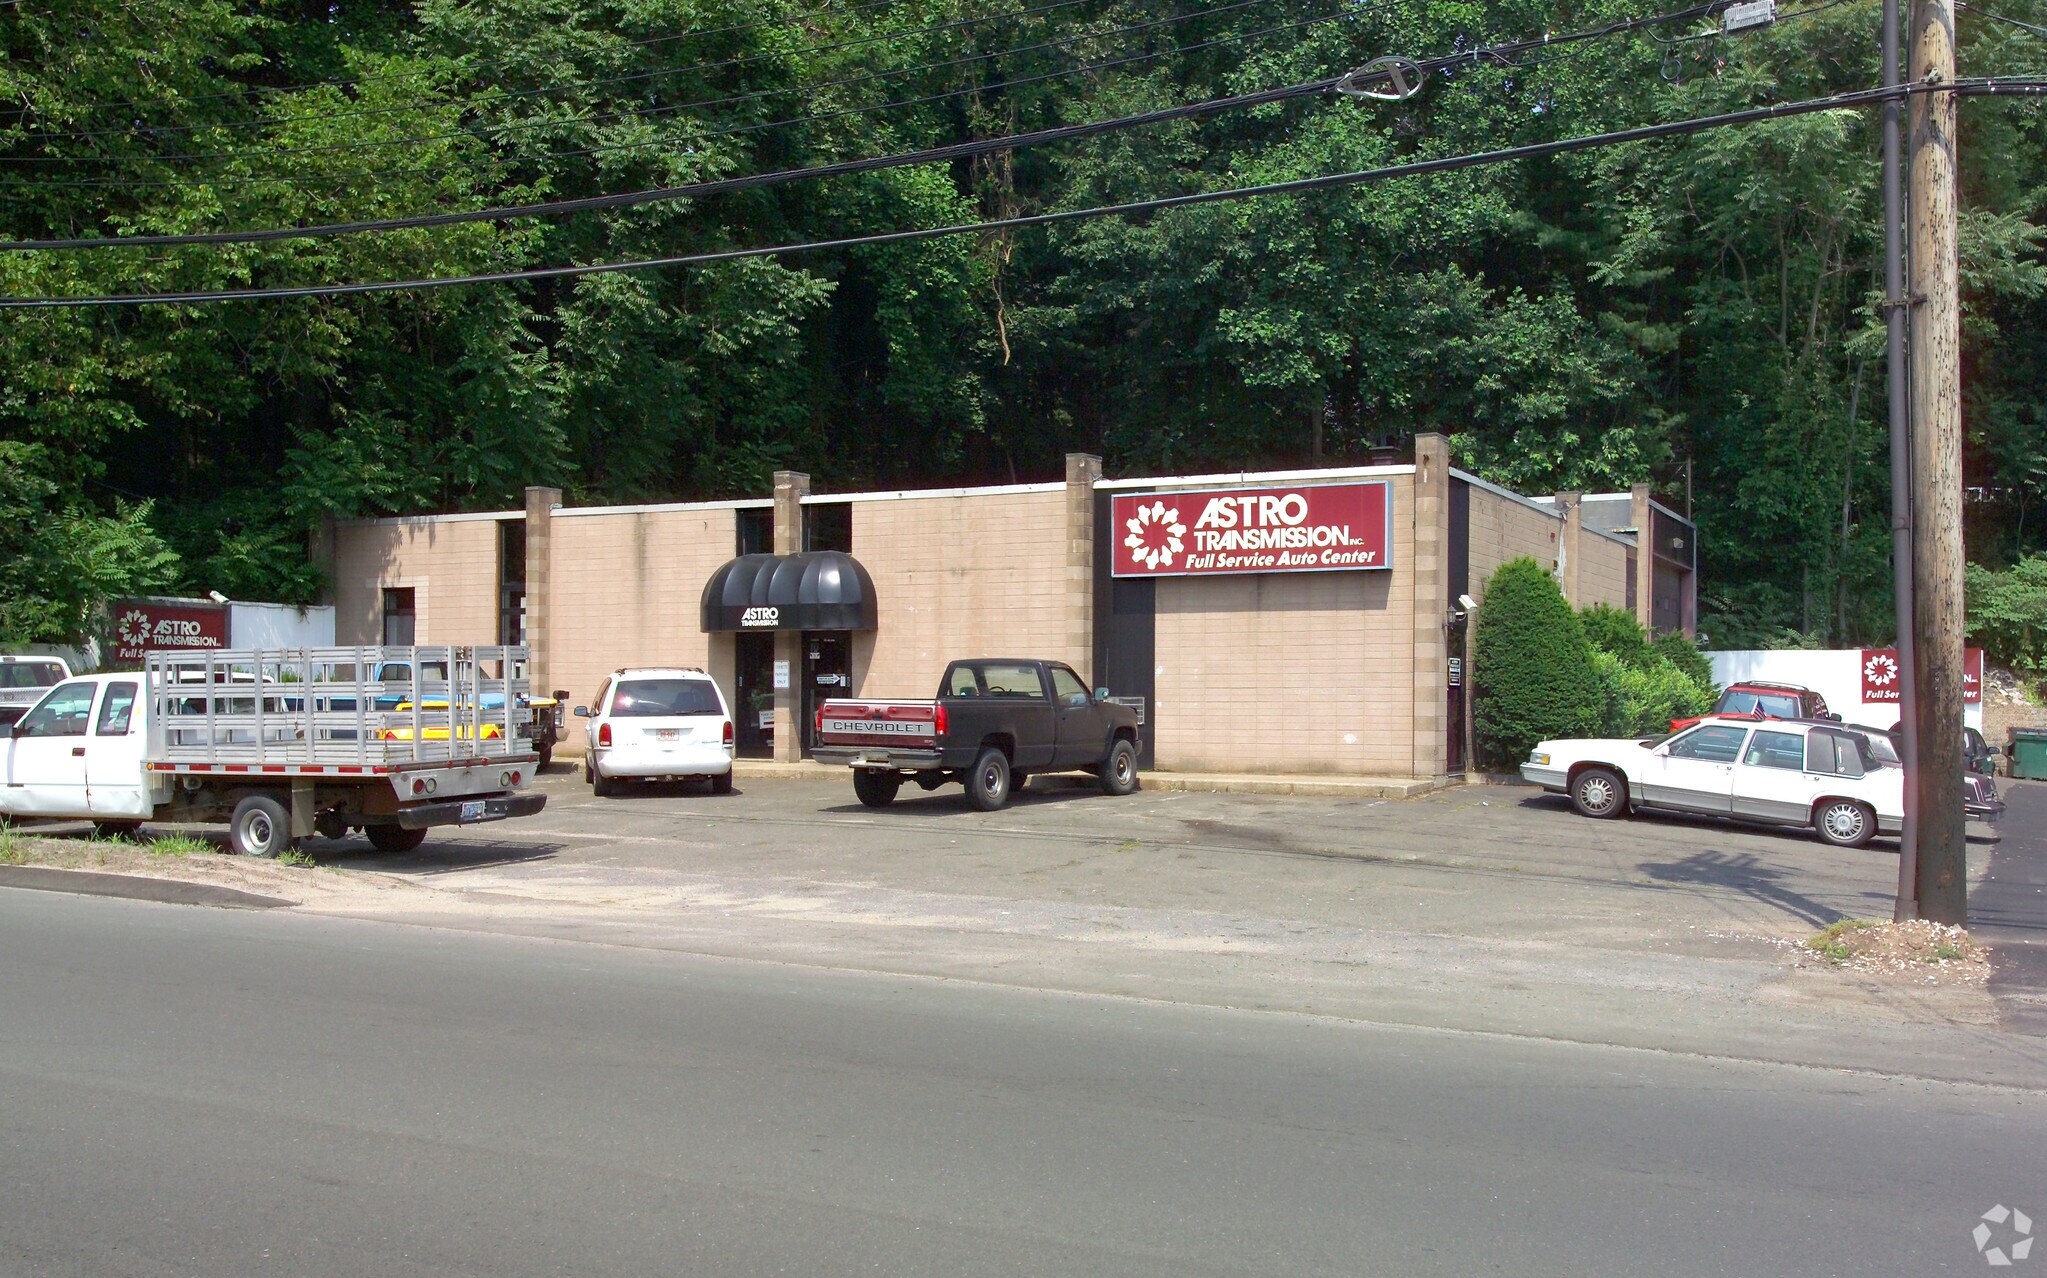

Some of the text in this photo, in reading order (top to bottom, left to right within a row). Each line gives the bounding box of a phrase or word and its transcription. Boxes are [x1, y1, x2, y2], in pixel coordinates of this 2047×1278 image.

[1194, 493, 1309, 529] ASTRO
[1193, 525, 1350, 552] TRANSMISSION
[1185, 549, 1376, 569] Full Service Auto Center
[741, 607, 779, 620] ASTRO
[153, 620, 201, 636] ASTRO
[153, 635, 217, 647] TRANSMISSION
[120, 648, 137, 658] Full
[1866, 690, 1884, 699] Full
[1963, 690, 1978, 698] ter
[833, 721, 924, 733] CHEVROLET
